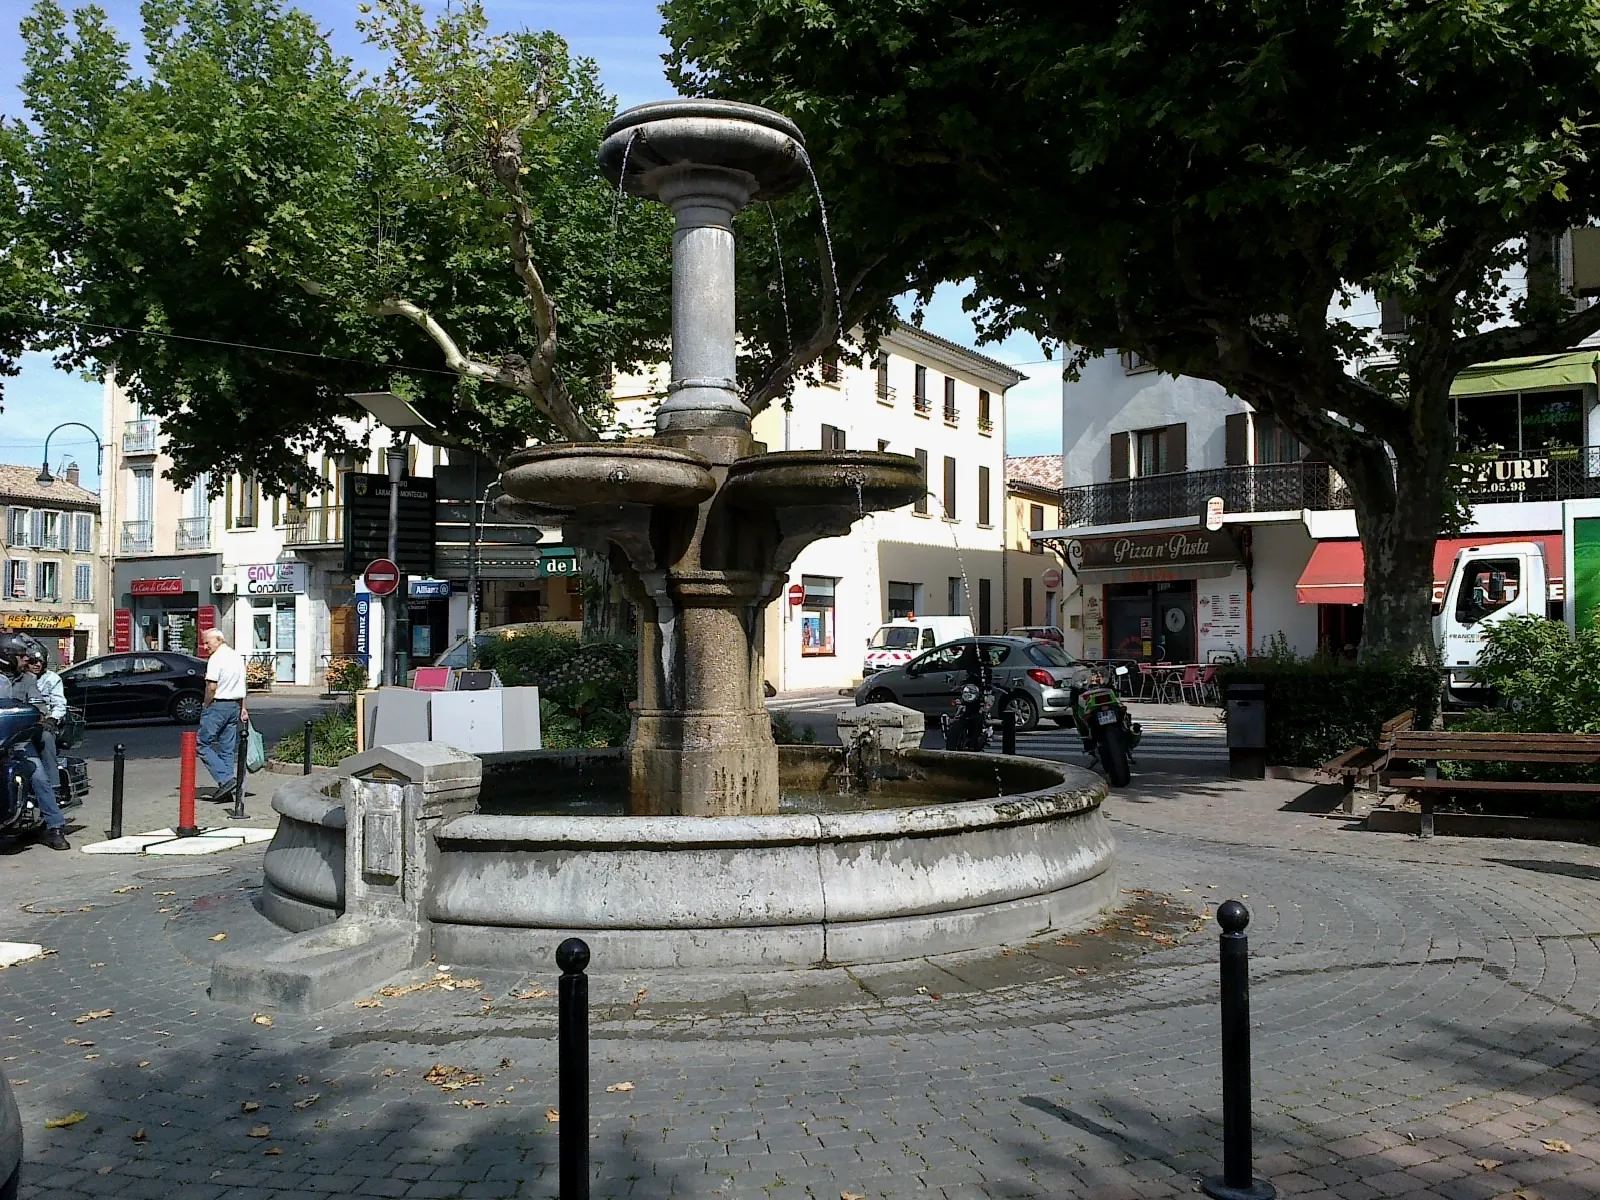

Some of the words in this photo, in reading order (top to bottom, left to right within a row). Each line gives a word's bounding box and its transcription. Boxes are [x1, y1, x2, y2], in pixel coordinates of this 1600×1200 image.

[1113, 538, 1153, 563] Pizza
[1168, 533, 1209, 559] Pasta
[546, 558, 567, 572] de
[415, 585, 439, 594] Allianz
[8, 614, 67, 622] RESTAURANT
[357, 616, 367, 653] Allianz
